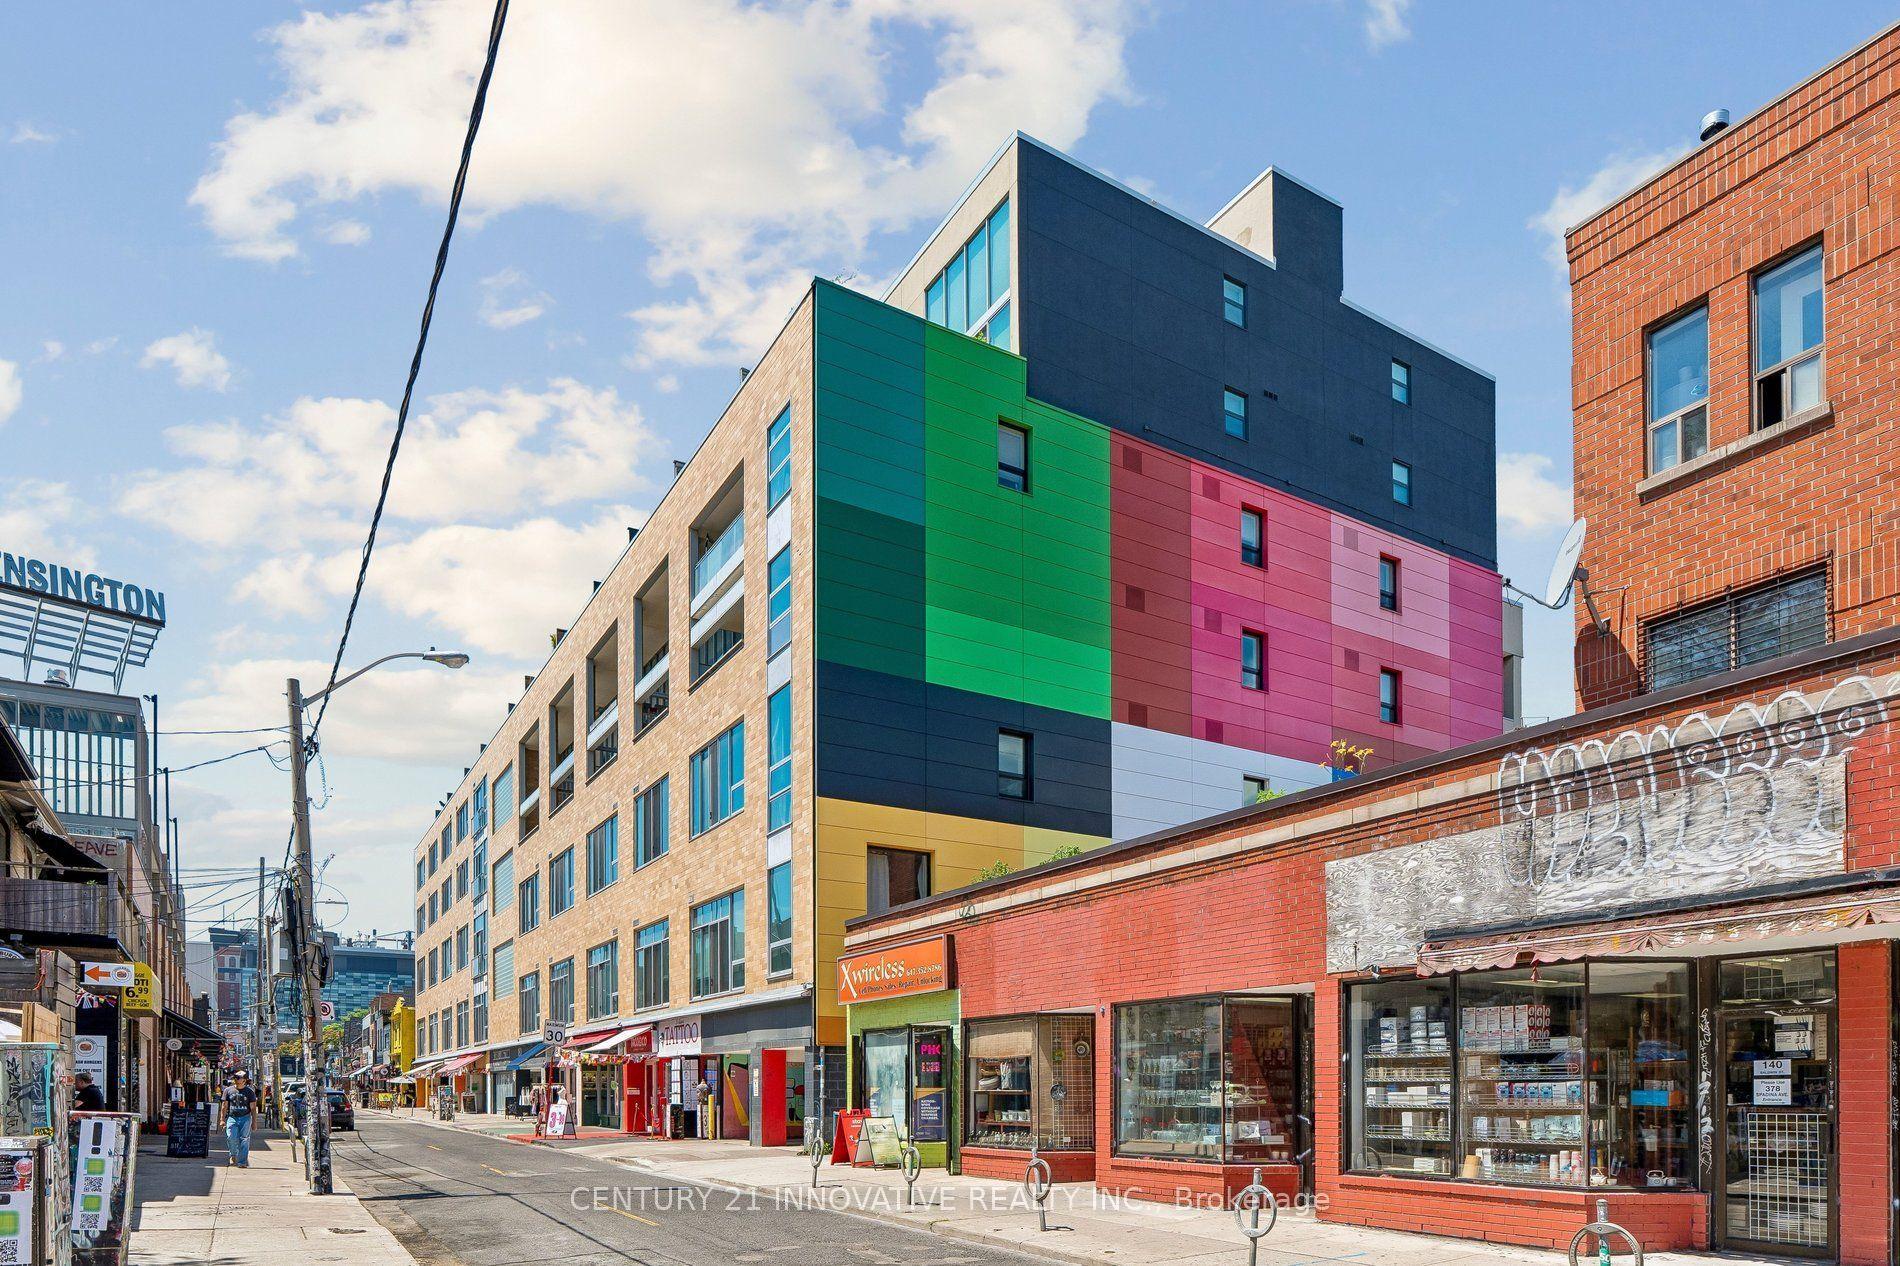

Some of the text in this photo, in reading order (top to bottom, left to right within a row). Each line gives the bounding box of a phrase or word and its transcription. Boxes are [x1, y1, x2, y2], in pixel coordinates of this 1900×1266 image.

[0, 552, 165, 622] NSINGTON
[841, 955, 905, 998] Xwireless
[546, 1030, 563, 1042] 30
[664, 1022, 699, 1046] TATTOO
[1762, 1060, 1783, 1069] 140
